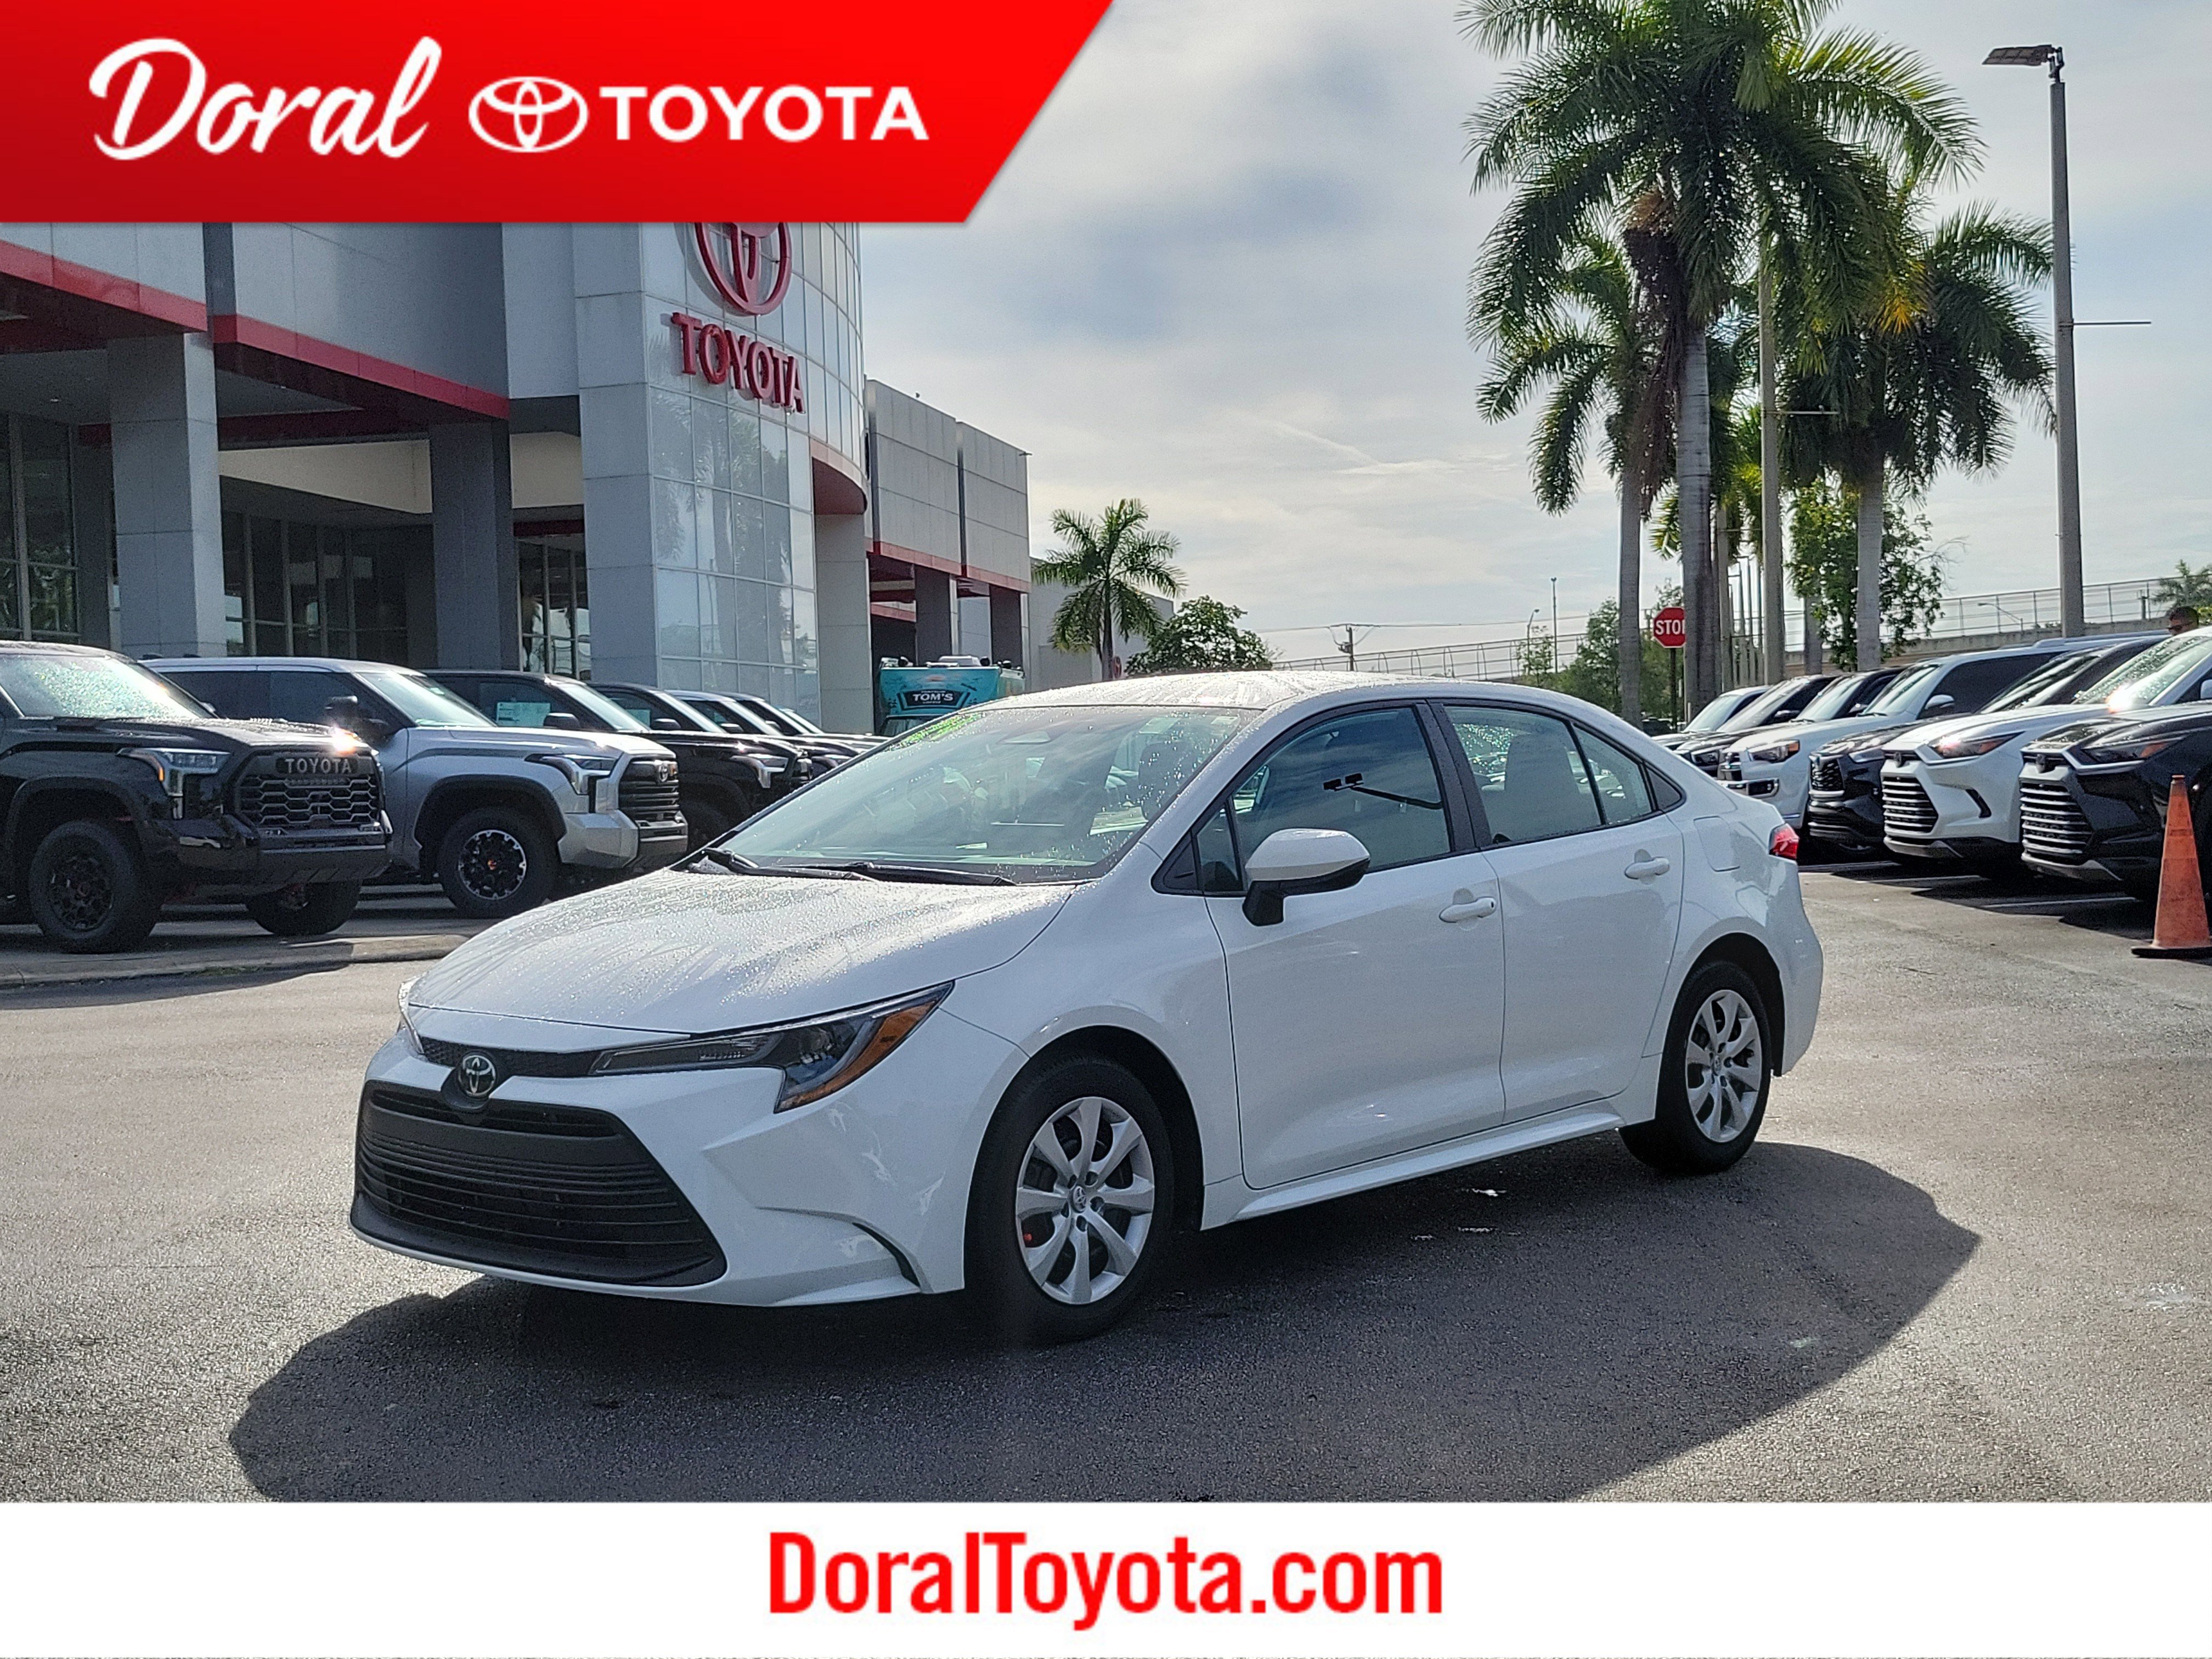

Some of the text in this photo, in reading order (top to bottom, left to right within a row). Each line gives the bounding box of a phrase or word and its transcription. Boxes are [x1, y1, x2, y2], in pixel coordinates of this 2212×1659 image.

[671, 312, 805, 414] TOYOTA
[912, 693, 953, 701] TOM'S
[285, 758, 352, 774] TOYOTA
